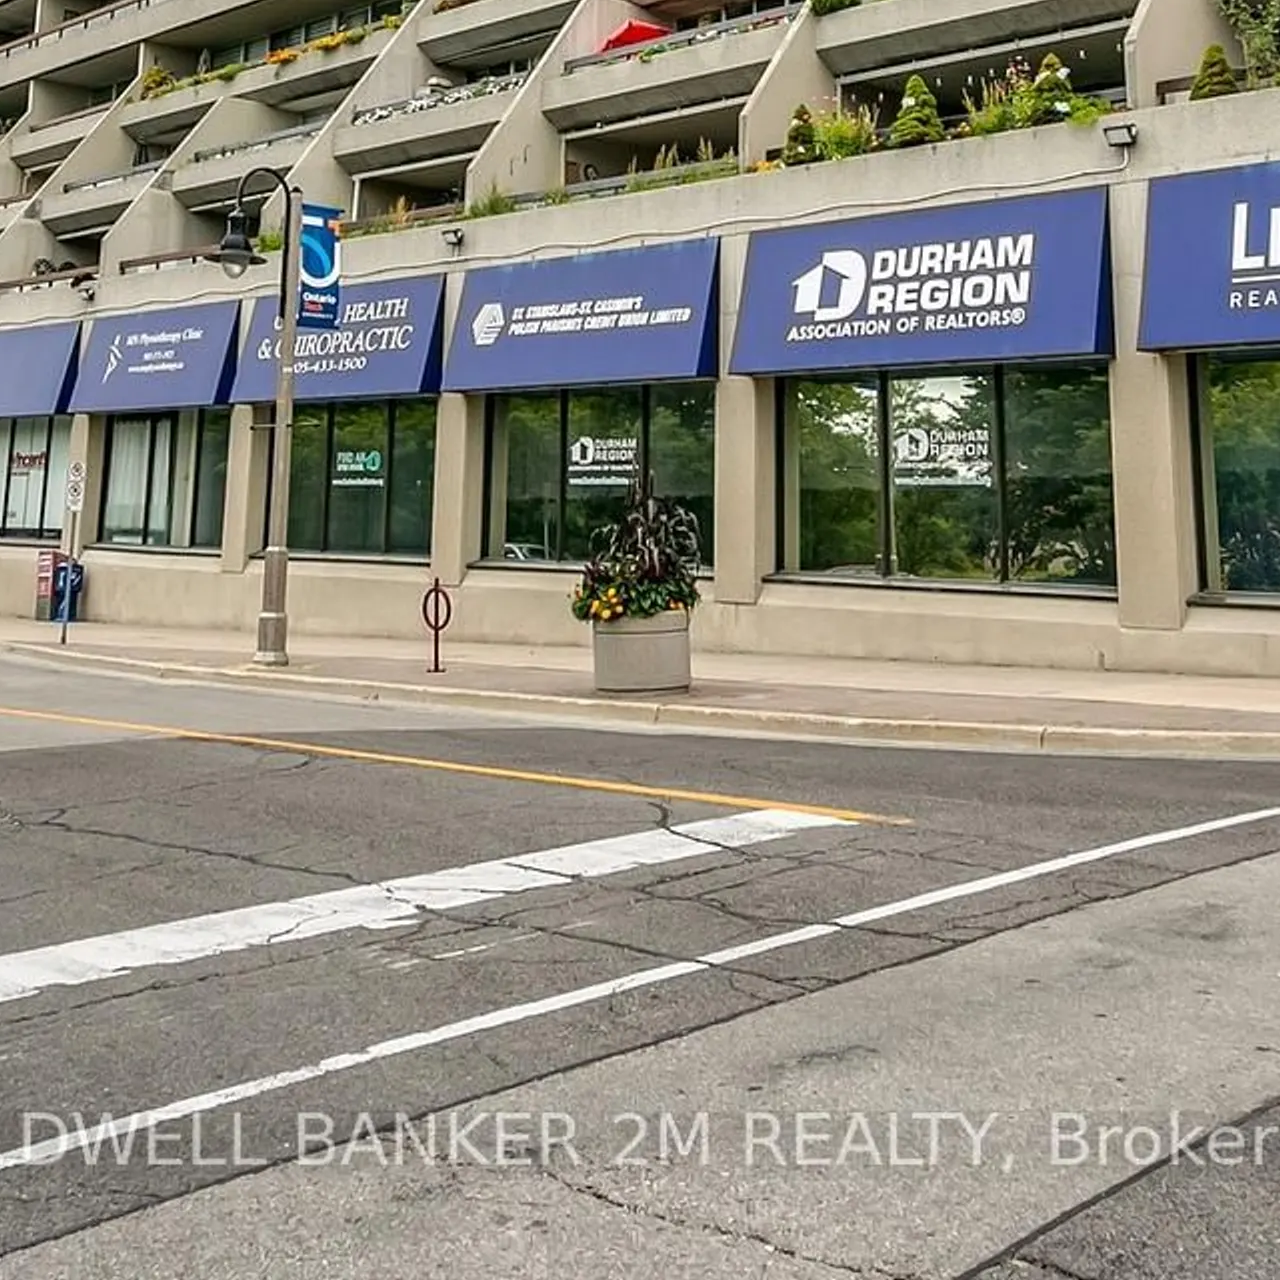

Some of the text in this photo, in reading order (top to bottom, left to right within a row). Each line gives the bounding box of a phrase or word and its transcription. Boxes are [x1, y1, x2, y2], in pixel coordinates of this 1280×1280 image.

[872, 234, 1033, 280] DURHAM
[867, 270, 1031, 315] REGION
[343, 298, 409, 323] HEALTH
[787, 320, 890, 341] ASSOCIATION
[896, 317, 919, 333] OF
[258, 338, 271, 359] &
